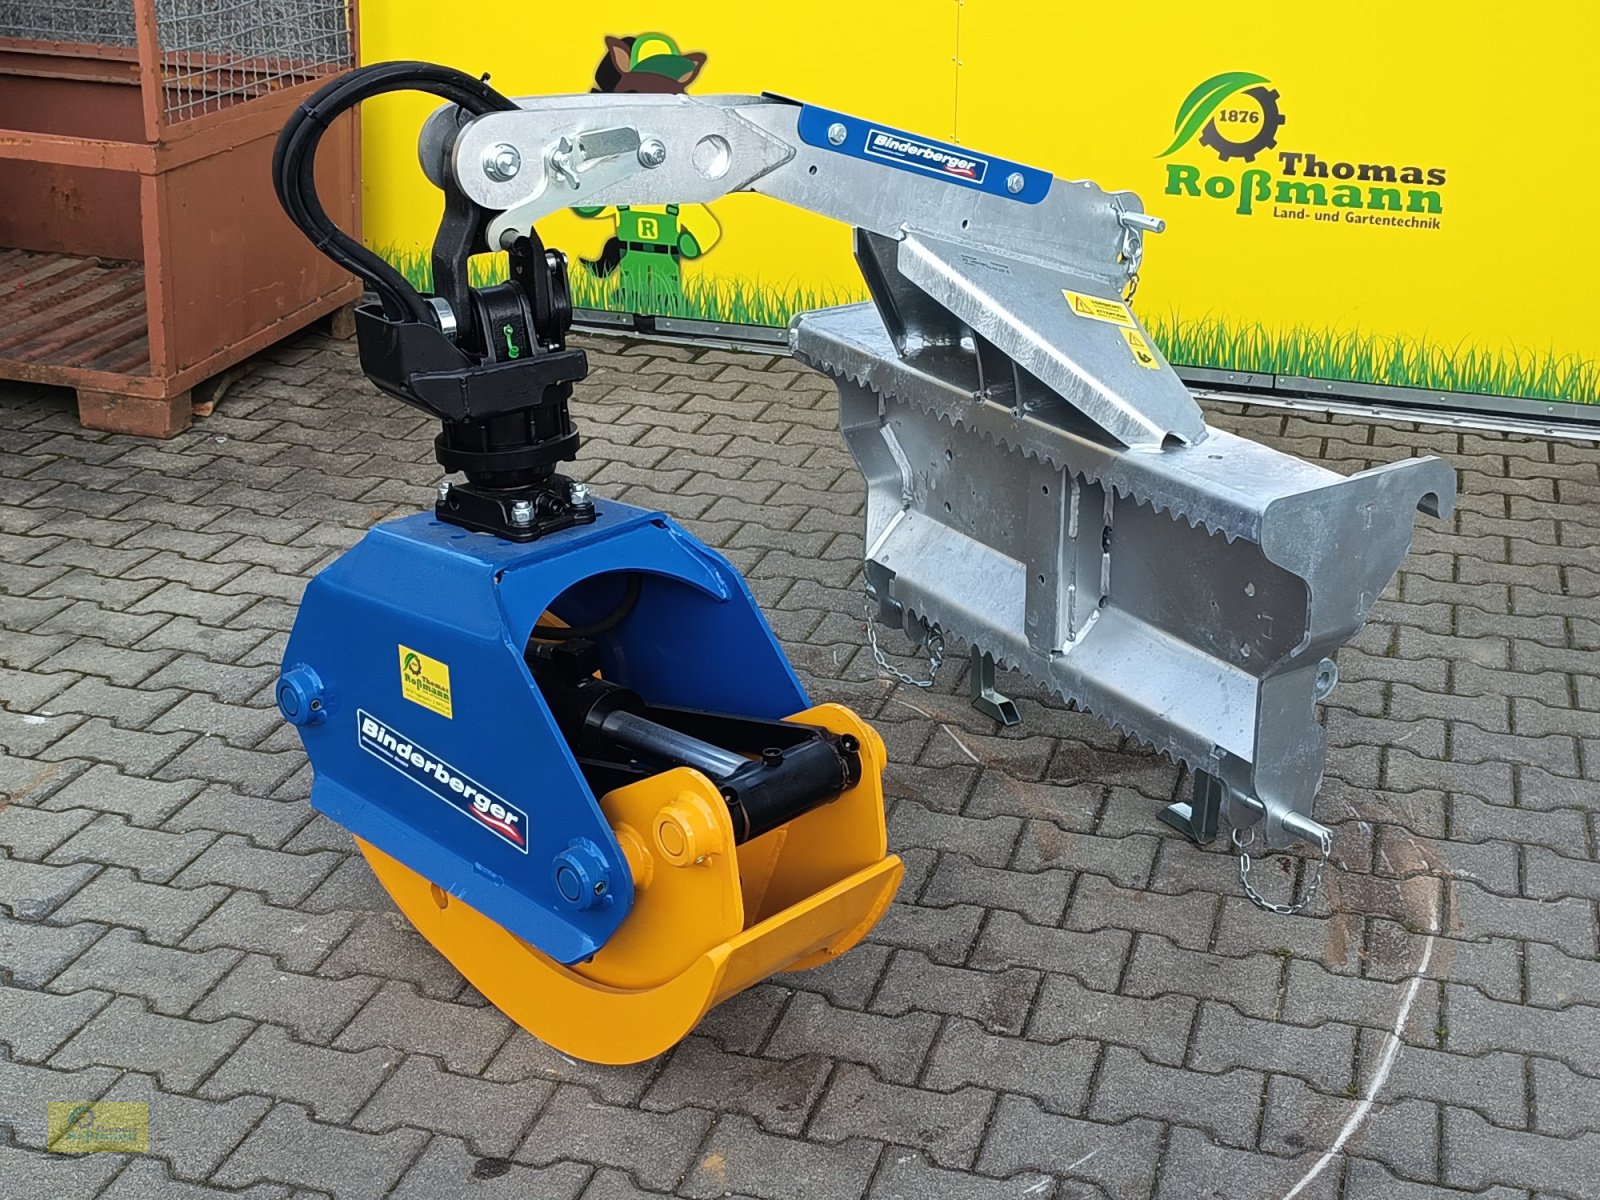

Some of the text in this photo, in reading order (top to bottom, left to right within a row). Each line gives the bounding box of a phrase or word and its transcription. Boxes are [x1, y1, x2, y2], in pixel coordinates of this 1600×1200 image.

[1219, 109, 1259, 124] 1876
[873, 134, 976, 170] Binderberger
[1278, 151, 1447, 186] Thomas
[1164, 163, 1444, 216] Roßmann
[642, 221, 655, 237] R
[1272, 206, 1441, 230] Land- und Gartentechnik
[361, 717, 519, 826] Binderberger
